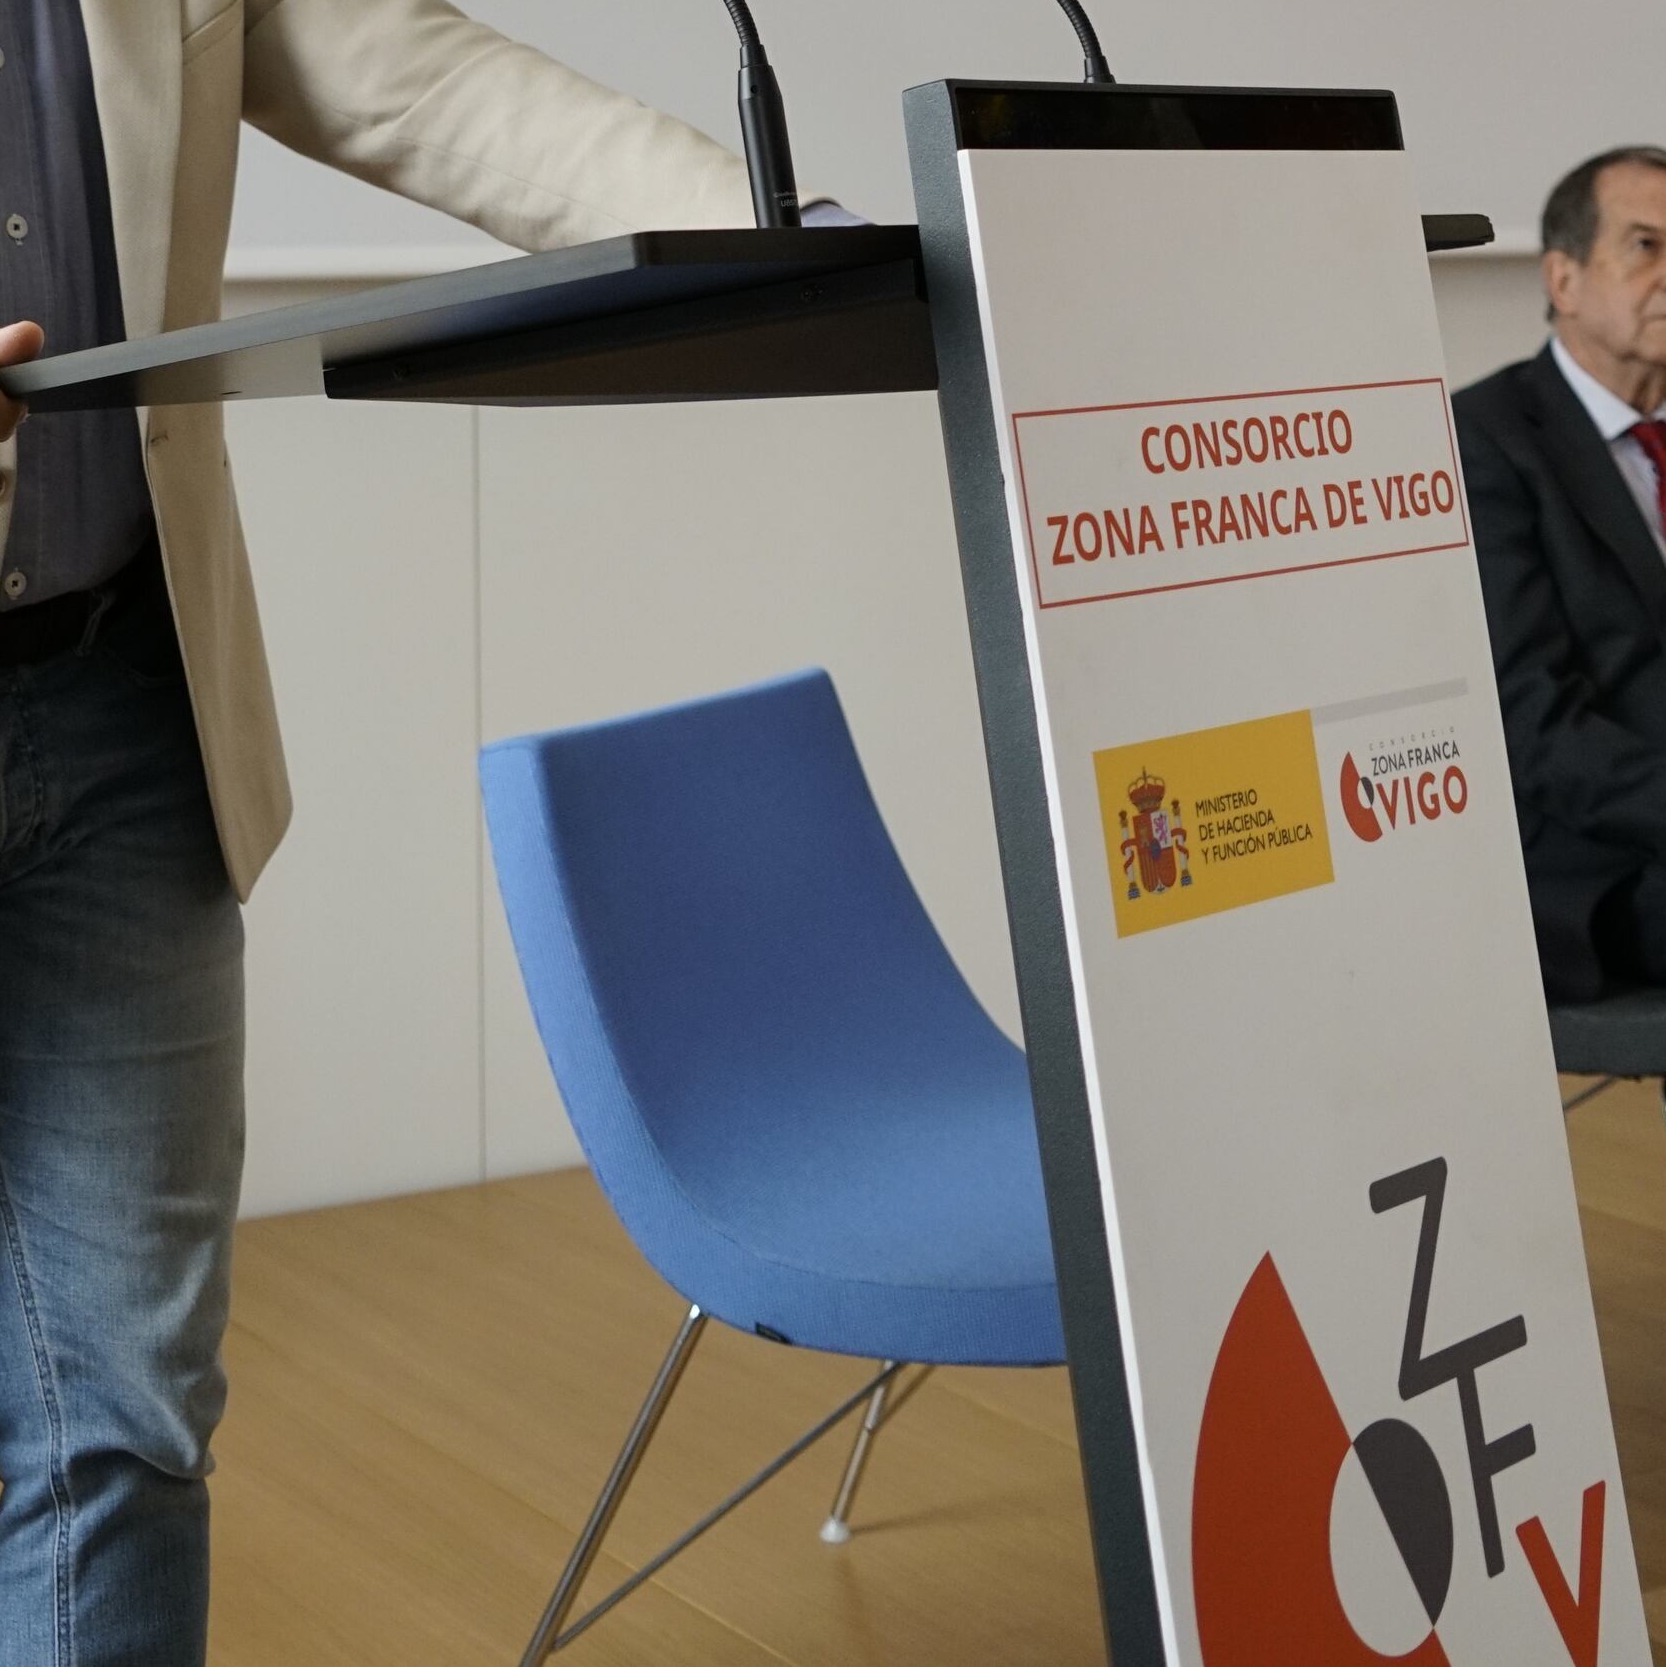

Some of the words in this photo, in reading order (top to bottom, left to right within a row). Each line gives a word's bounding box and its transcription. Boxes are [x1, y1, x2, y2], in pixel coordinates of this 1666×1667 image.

[1140, 409, 1353, 474] CONSORCIO
[1046, 505, 1165, 566] ZONA
[1170, 486, 1318, 549] FRANCA
[1322, 480, 1369, 529] DE
[1371, 469, 1455, 522] VIGO
[1195, 789, 1258, 818] MINISTERIO
[1375, 765, 1468, 831] VIGO
[1198, 823, 1215, 841] DE
[1217, 809, 1275, 837] HACIENDA
[1201, 848, 1209, 865] Y
[1213, 833, 1266, 862] FUNCIÓN
[1267, 823, 1313, 849] PÚBLICA
